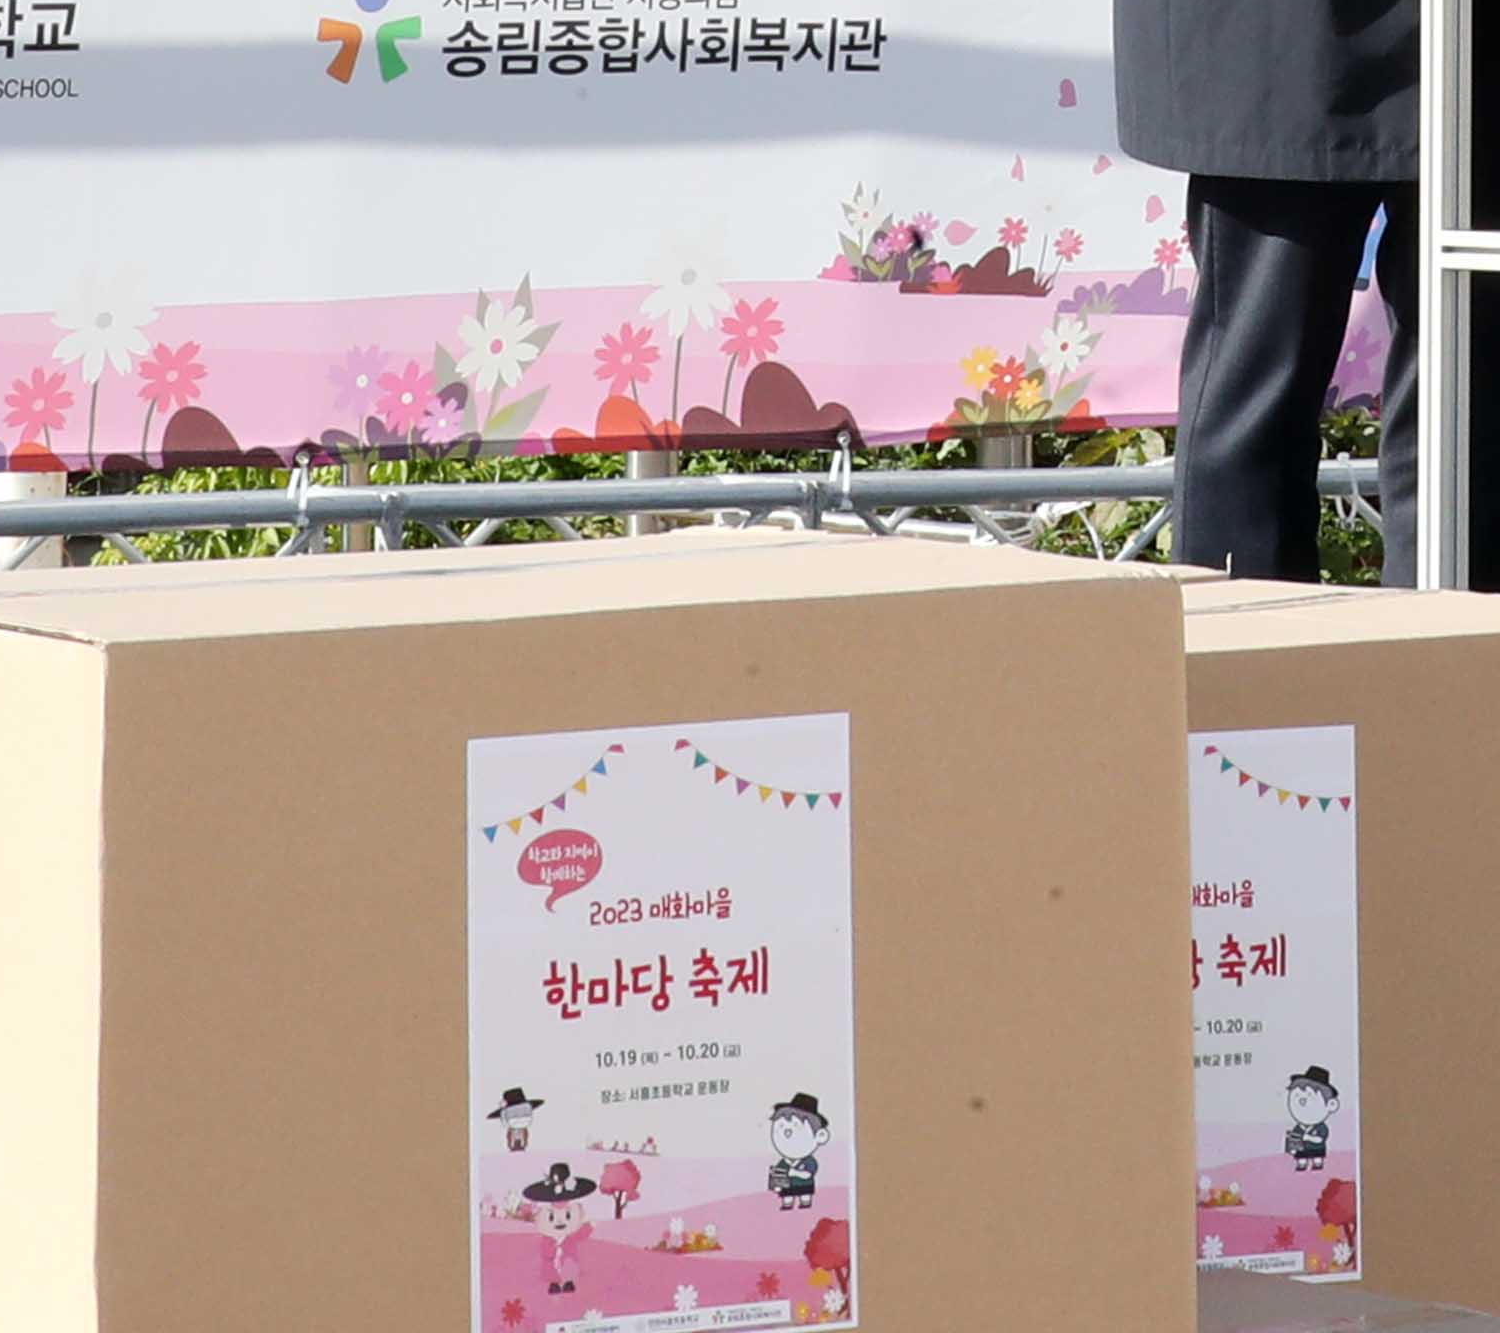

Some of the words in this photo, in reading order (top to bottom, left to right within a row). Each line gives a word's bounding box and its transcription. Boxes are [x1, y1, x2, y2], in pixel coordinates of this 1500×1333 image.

[442, 17, 887, 77] 송림종합사회복지관
[590, 898, 643, 925] 2023
[650, 888, 731, 919] 매화마을
[1193, 880, 1253, 908] 화마을
[1217, 933, 1286, 987] 축제
[543, 955, 673, 1019] 한마당
[689, 947, 768, 1006] 축제
[1206, 1018, 1244, 1034] 10.20
[596, 1050, 636, 1067] 10.19
[678, 1043, 719, 1060] 10.20
